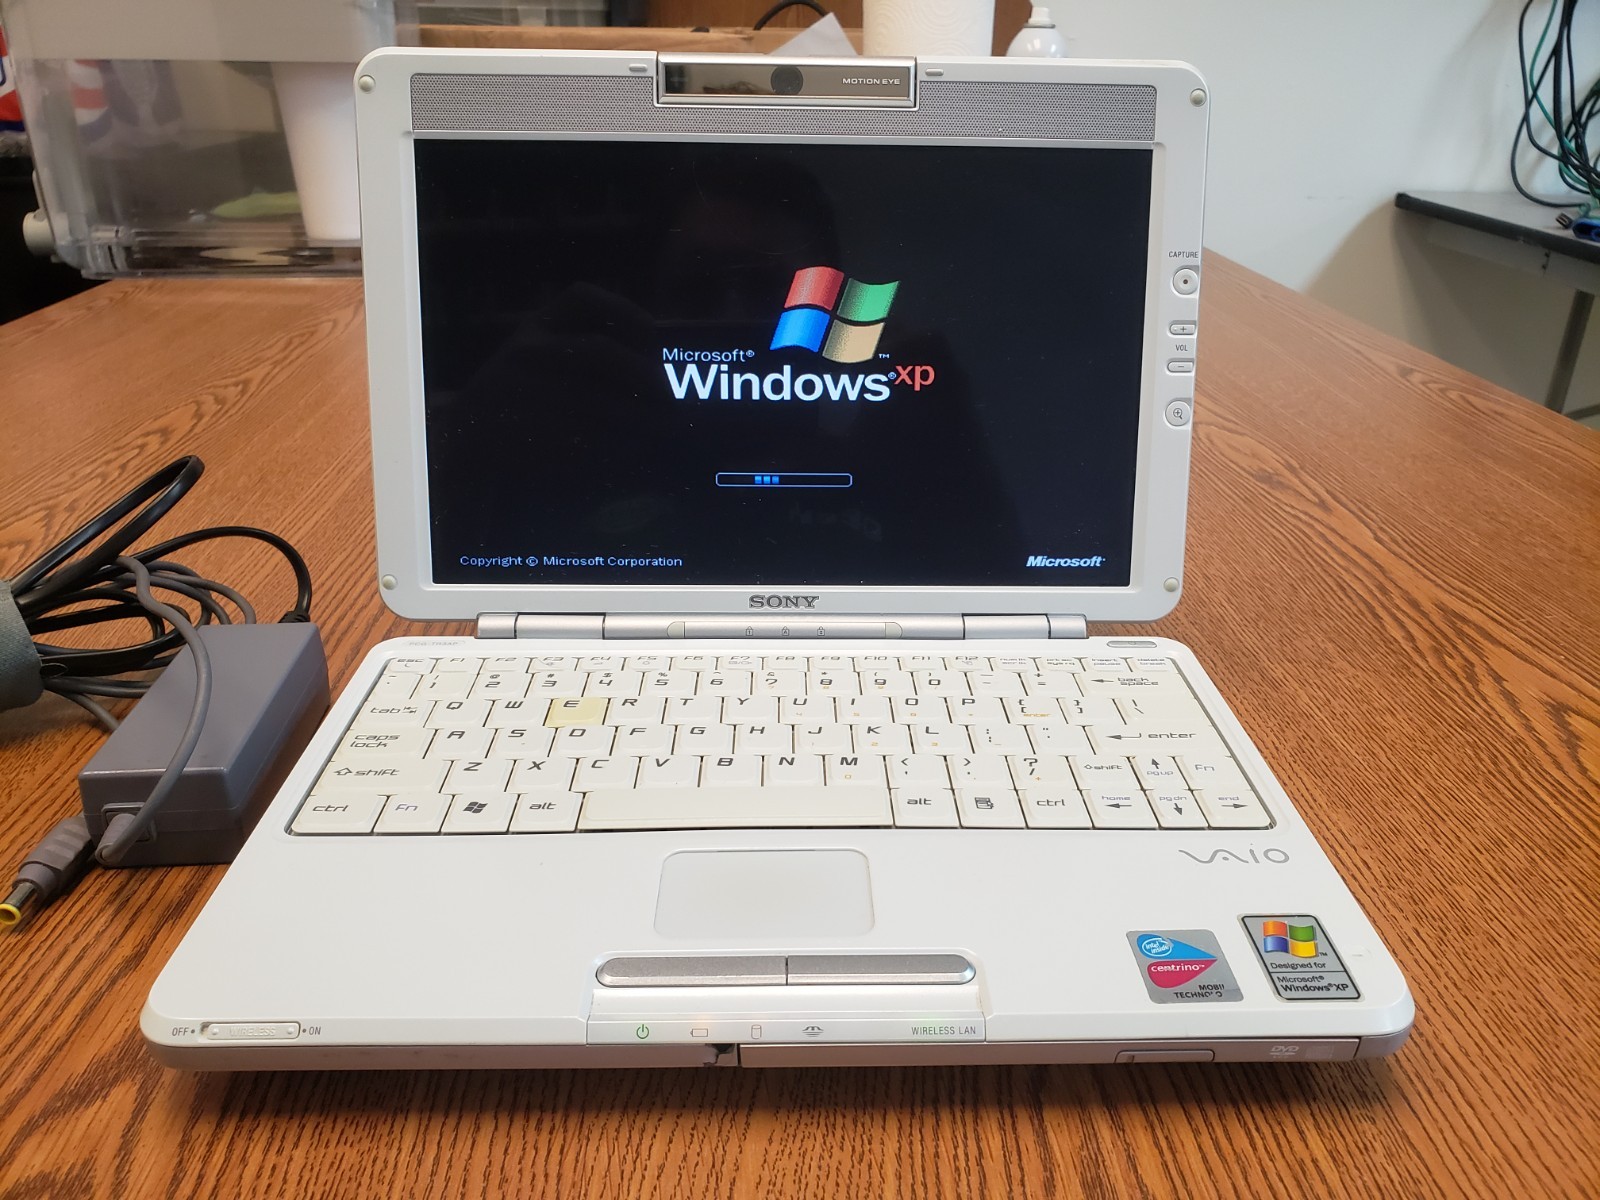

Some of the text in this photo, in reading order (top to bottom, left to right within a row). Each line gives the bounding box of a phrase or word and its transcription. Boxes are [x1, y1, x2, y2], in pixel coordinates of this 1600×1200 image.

[1175, 344, 1188, 352] VOL
[894, 365, 935, 391] xp
[460, 556, 523, 568] Copyright
[543, 556, 604, 567] Microsoft
[607, 556, 683, 568] Corporation
[748, 594, 820, 609] SONY
[446, 701, 463, 710] Q
[504, 700, 523, 709] W
[563, 700, 580, 708] E
[621, 698, 638, 706] R
[680, 698, 694, 706] T
[737, 697, 750, 705] Y
[447, 730, 465, 739] A
[508, 729, 527, 738] S
[569, 728, 587, 737] D
[629, 727, 647, 736] F
[690, 726, 707, 735] G
[749, 726, 765, 734] H
[808, 726, 822, 734] J
[867, 726, 881, 734] K
[925, 726, 939, 734] L
[527, 760, 546, 771] X
[590, 759, 610, 769] C
[655, 758, 670, 767] V
[717, 757, 734, 766] B
[778, 757, 795, 766] N
[840, 757, 858, 766] M
[1023, 758, 1038, 767] ?
[463, 762, 483, 771] Z
[1195, 764, 1215, 772] Fn
[312, 804, 349, 812] ctrl
[395, 803, 418, 812] Fn
[529, 802, 557, 810] alt
[1178, 843, 1289, 864] VAIO
[1270, 962, 1313, 970] Designed
[1334, 983, 1349, 991] XP
[172, 1027, 189, 1037] OFF
[229, 1026, 276, 1037] WIRELESS
[309, 1026, 321, 1035] ON
[911, 1025, 977, 1035] WIRELESS LAN
